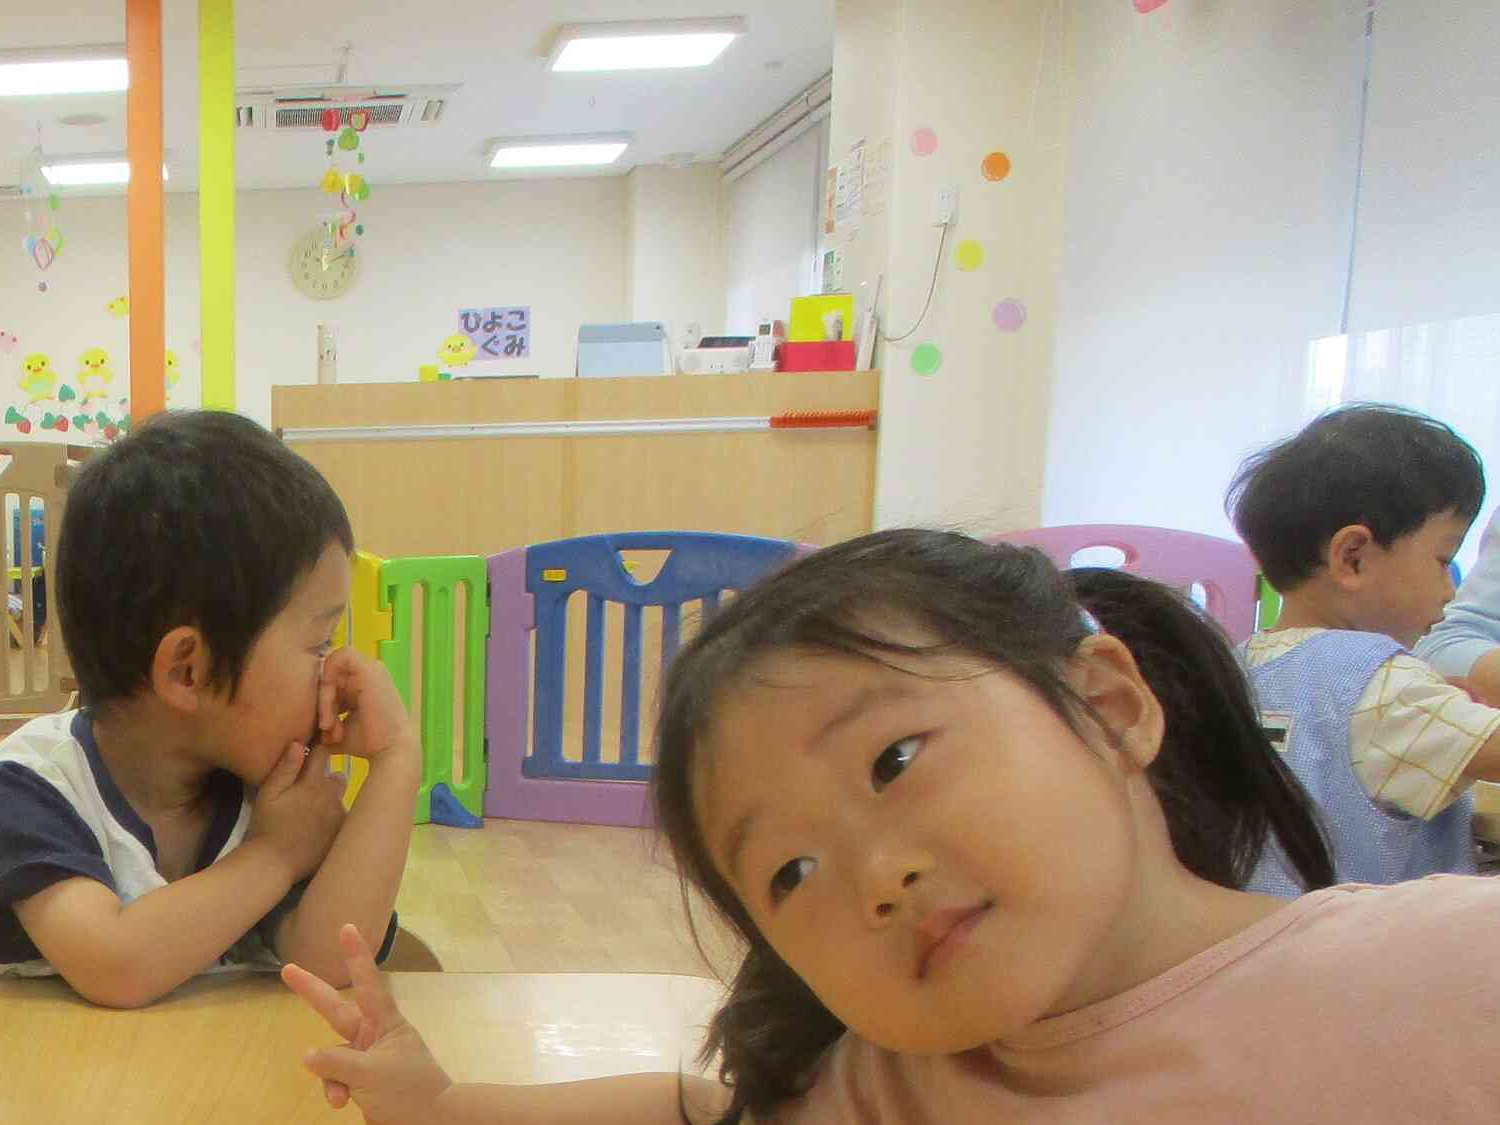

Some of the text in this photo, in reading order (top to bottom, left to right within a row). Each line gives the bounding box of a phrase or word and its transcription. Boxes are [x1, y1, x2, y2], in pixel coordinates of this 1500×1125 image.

[460, 309, 527, 334] ひよこ
[481, 334, 526, 357] ぐみ
